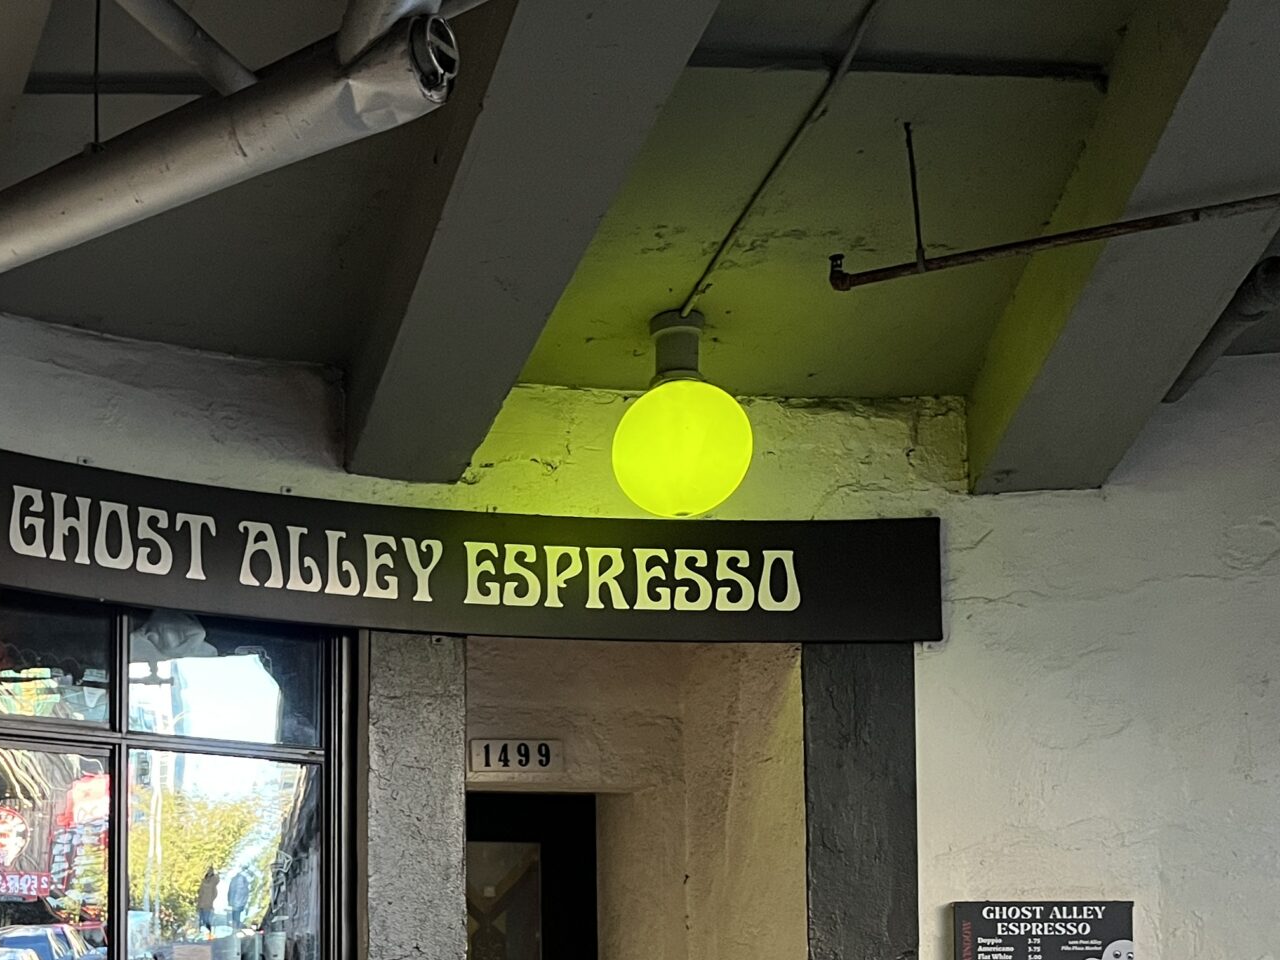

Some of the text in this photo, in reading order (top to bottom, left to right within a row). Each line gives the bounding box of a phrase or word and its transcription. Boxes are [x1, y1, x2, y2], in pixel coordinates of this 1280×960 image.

[9, 485, 801, 611] GHOST ALLEY ESPRESSO
[483, 743, 551, 768] 1499
[982, 907, 1106, 919] GHOST ALLEY
[997, 922, 1091, 935] ESPRESSO
[978, 937, 1002, 945] Doppio
